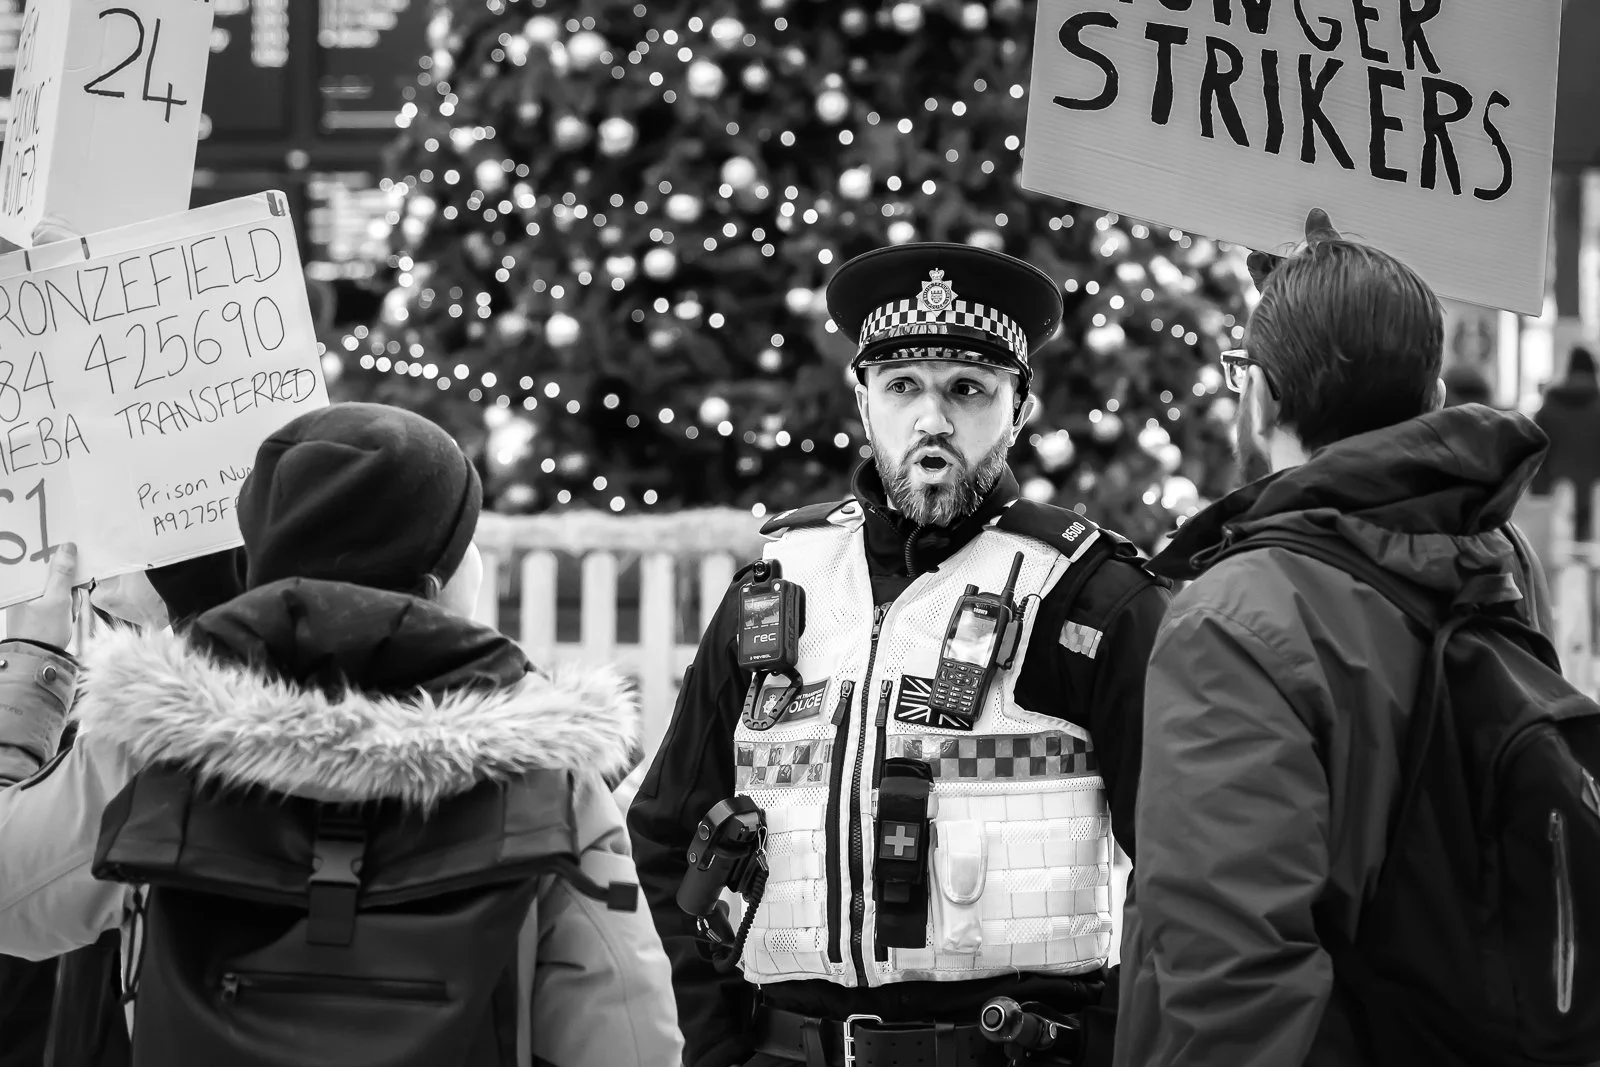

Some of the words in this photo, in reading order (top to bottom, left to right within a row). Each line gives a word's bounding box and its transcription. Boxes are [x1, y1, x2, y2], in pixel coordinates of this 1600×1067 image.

[84, 8, 187, 122] 24
[1053, 12, 1512, 200] STRIKERS
[84, 296, 285, 394] 425690
[114, 368, 316, 438] TRANSFERRED
[137, 478, 208, 510] Prison
[1061, 521, 1086, 542] 8500
[753, 632, 777, 643] rec
[788, 693, 822, 713] OLICE
